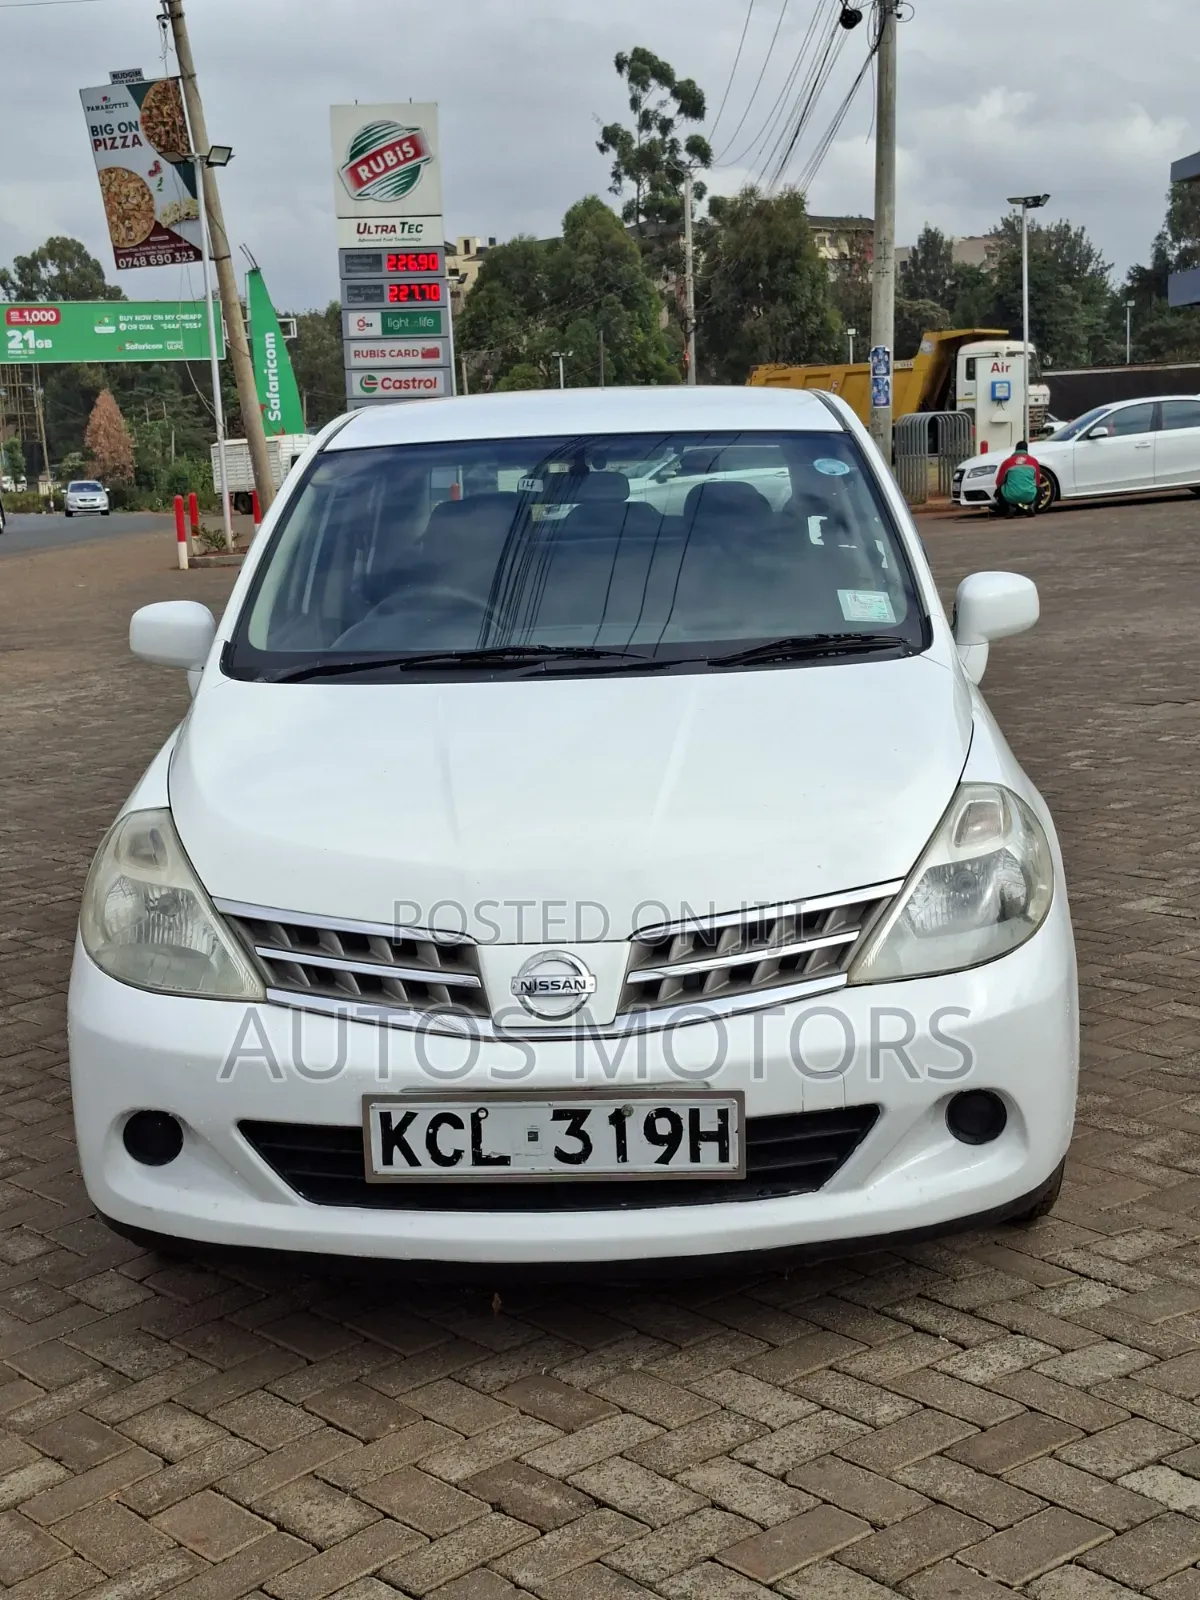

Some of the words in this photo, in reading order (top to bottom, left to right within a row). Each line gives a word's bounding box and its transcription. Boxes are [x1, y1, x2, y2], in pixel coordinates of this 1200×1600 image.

[90, 123, 114, 137] BIG
[117, 120, 139, 134] ON
[92, 134, 143, 152] PIZZA
[118, 256, 147, 268] 0748
[149, 253, 172, 265] 690
[174, 250, 195, 262] 323
[23, 310, 57, 324] 1,000
[387, 317, 409, 330] light
[419, 316, 434, 328] life
[354, 349, 387, 359] RUBIS
[388, 348, 419, 358] CARD
[990, 362, 1011, 373] Air
[264, 332, 281, 421] Safaricom
[381, 376, 437, 390] Castrol
[520, 979, 587, 991] NISSAN
[379, 1107, 511, 1167] KCL
[550, 1107, 730, 1166] 319H
